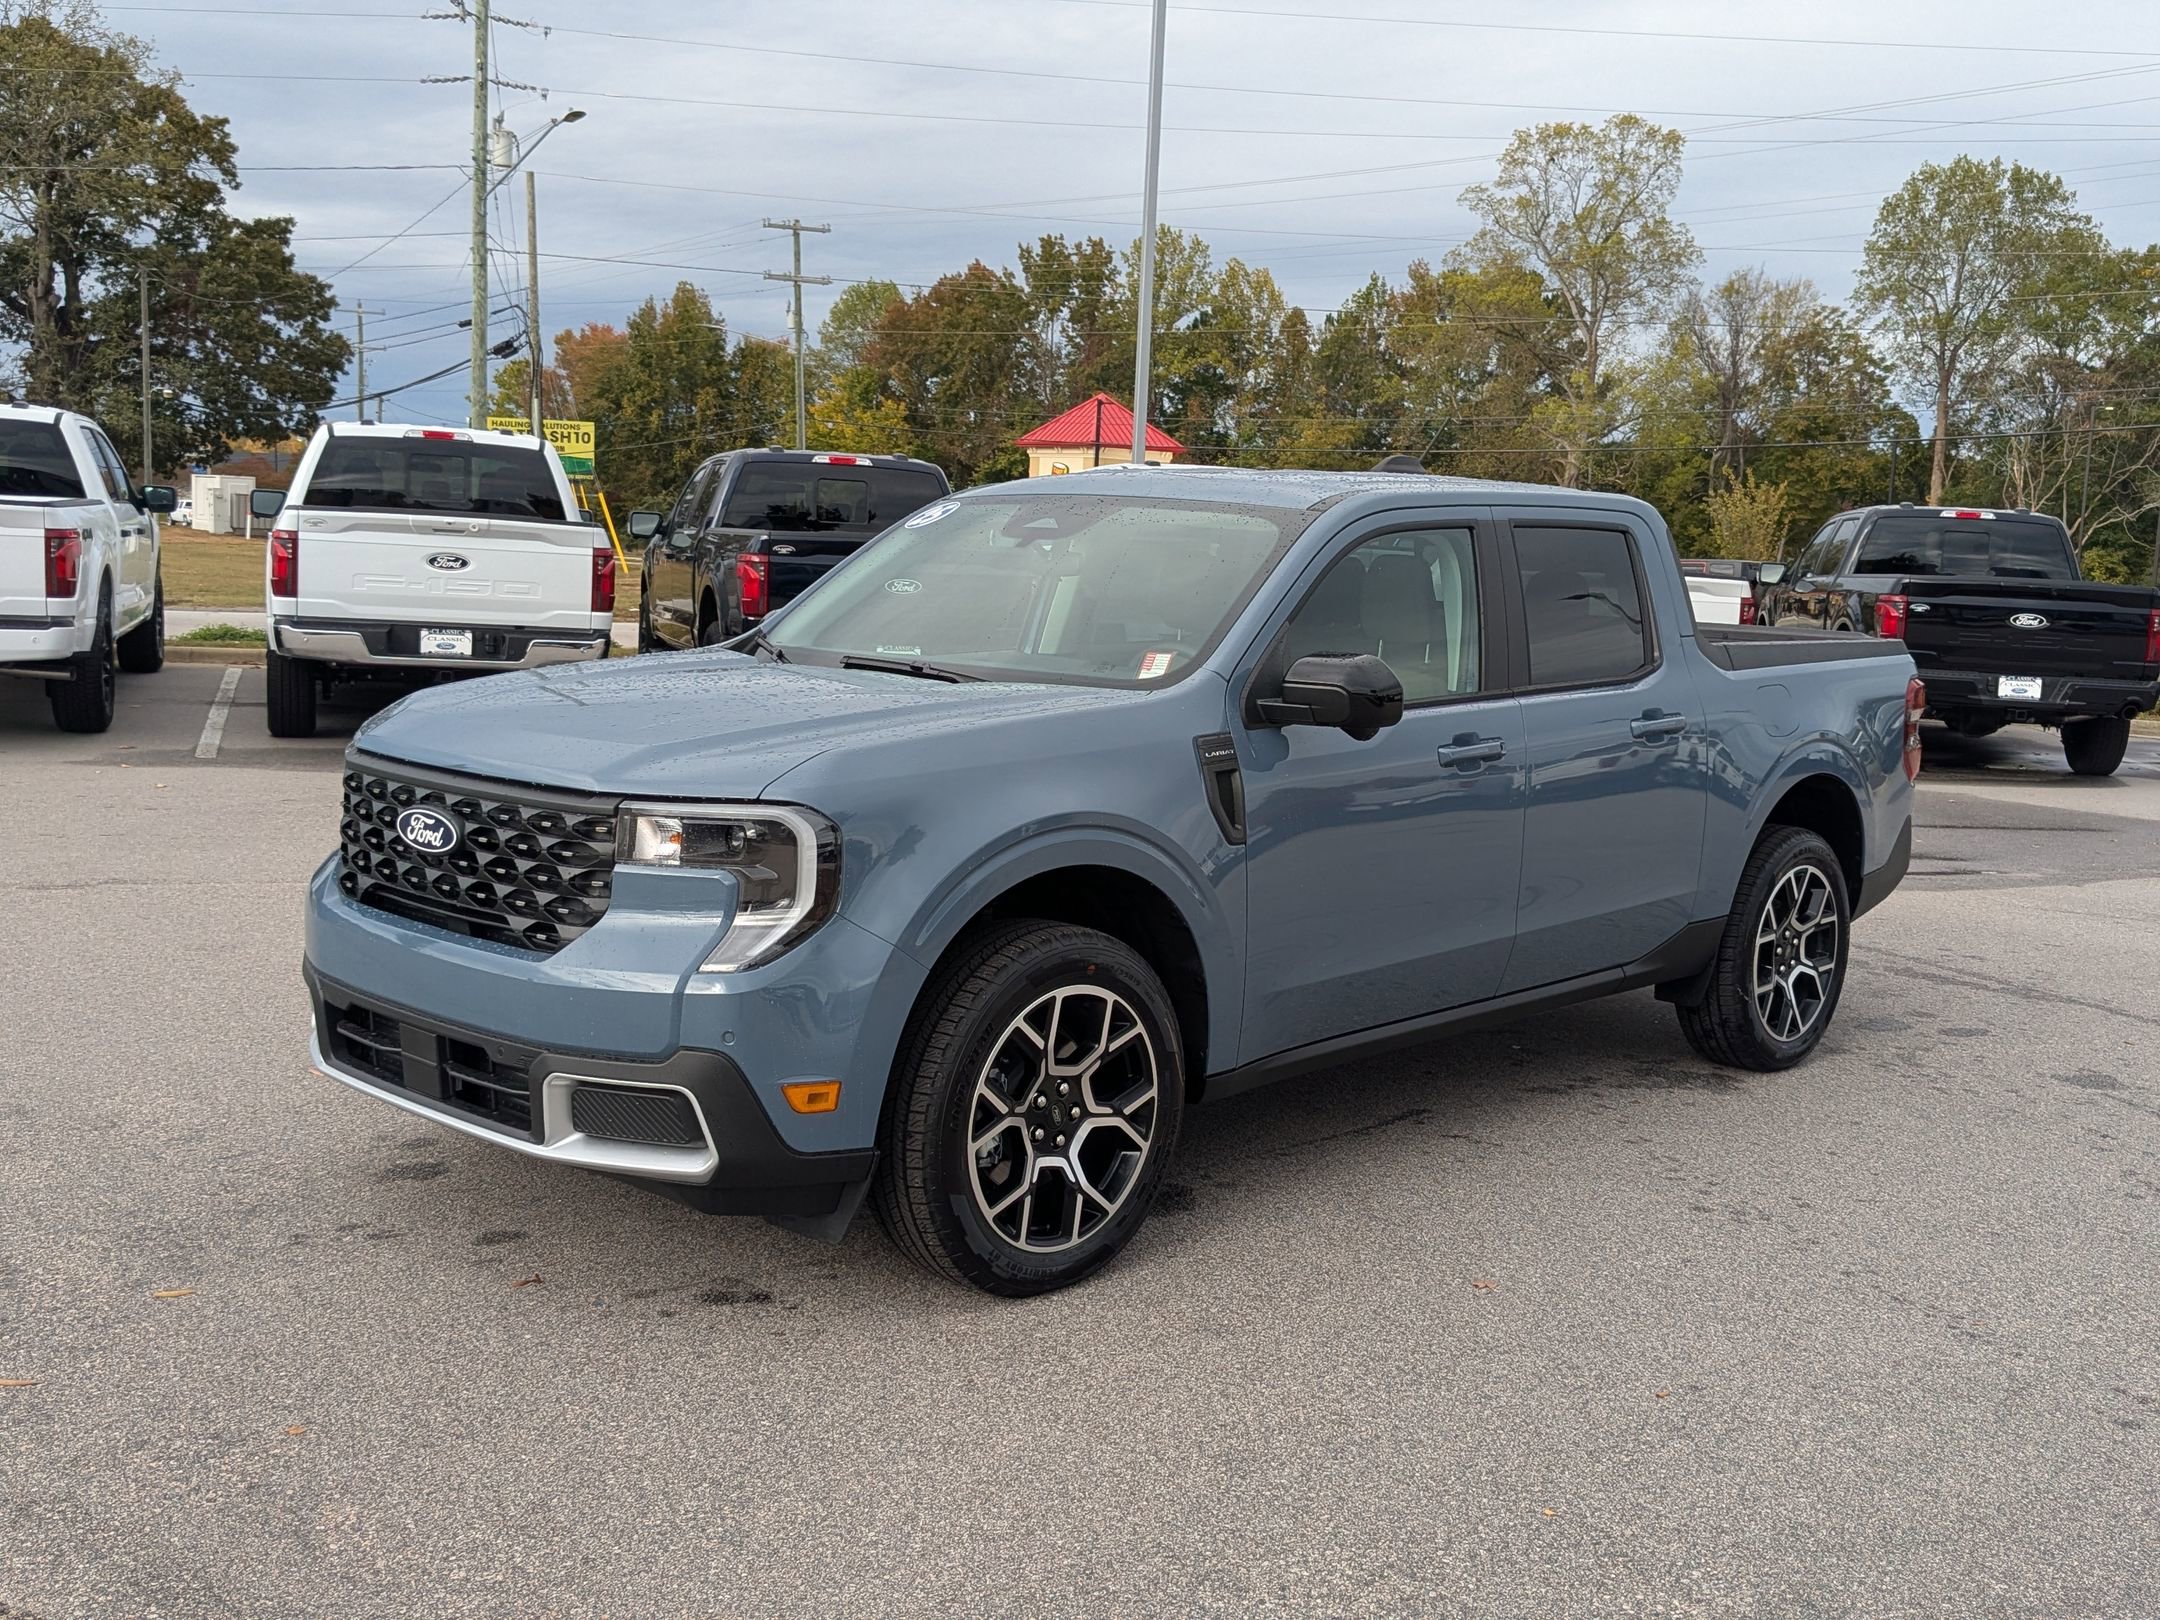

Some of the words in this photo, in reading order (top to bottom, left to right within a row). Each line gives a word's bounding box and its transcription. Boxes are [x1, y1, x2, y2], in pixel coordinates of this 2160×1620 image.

[491, 419, 530, 428] HAULING
[434, 556, 463, 568] Ford
[352, 573, 542, 599] F-150
[891, 580, 916, 592] Ford
[2015, 615, 2040, 626] Ford
[1205, 749, 1234, 758] LARIAT
[407, 813, 445, 847] Ford
